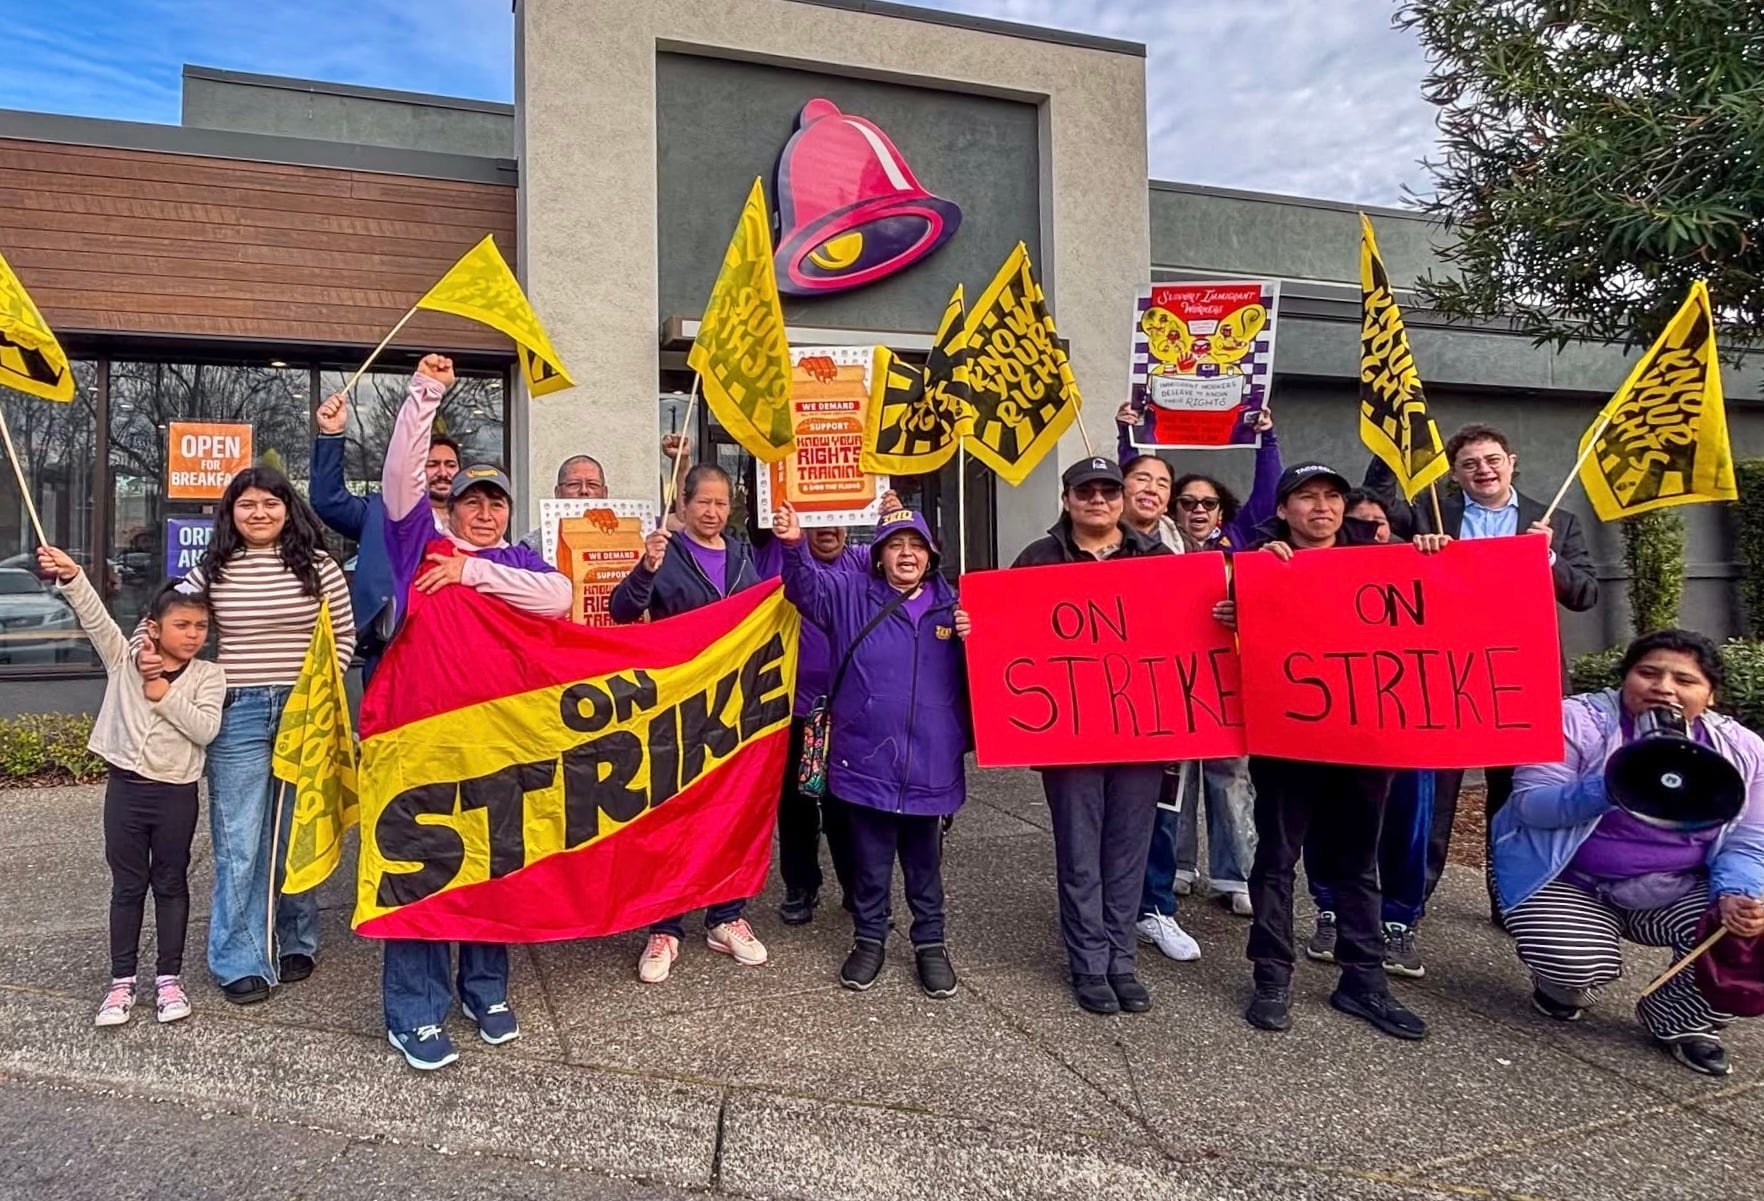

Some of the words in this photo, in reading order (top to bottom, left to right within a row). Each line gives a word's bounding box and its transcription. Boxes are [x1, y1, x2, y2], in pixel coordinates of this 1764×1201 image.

[997, 353, 1059, 428] RIGH
[801, 403, 816, 411] WE
[818, 402, 854, 411] DEMAND
[1185, 397, 1226, 408] RIGHTS
[809, 422, 849, 431] SUPPORT
[181, 435, 240, 459] OPEN
[796, 436, 830, 447] KNOW
[201, 460, 220, 470] FOR
[797, 446, 861, 465] RIGHTS
[171, 471, 232, 487] BREAKFA
[588, 552, 602, 560] WE
[603, 551, 635, 560] DEMAND
[1355, 579, 1425, 626] ON
[1051, 596, 1128, 643] ON
[1004, 647, 1246, 736] STRIKE
[1283, 647, 1532, 730] STRIKE
[559, 669, 659, 733] ON
[374, 632, 791, 908] STRIKE
